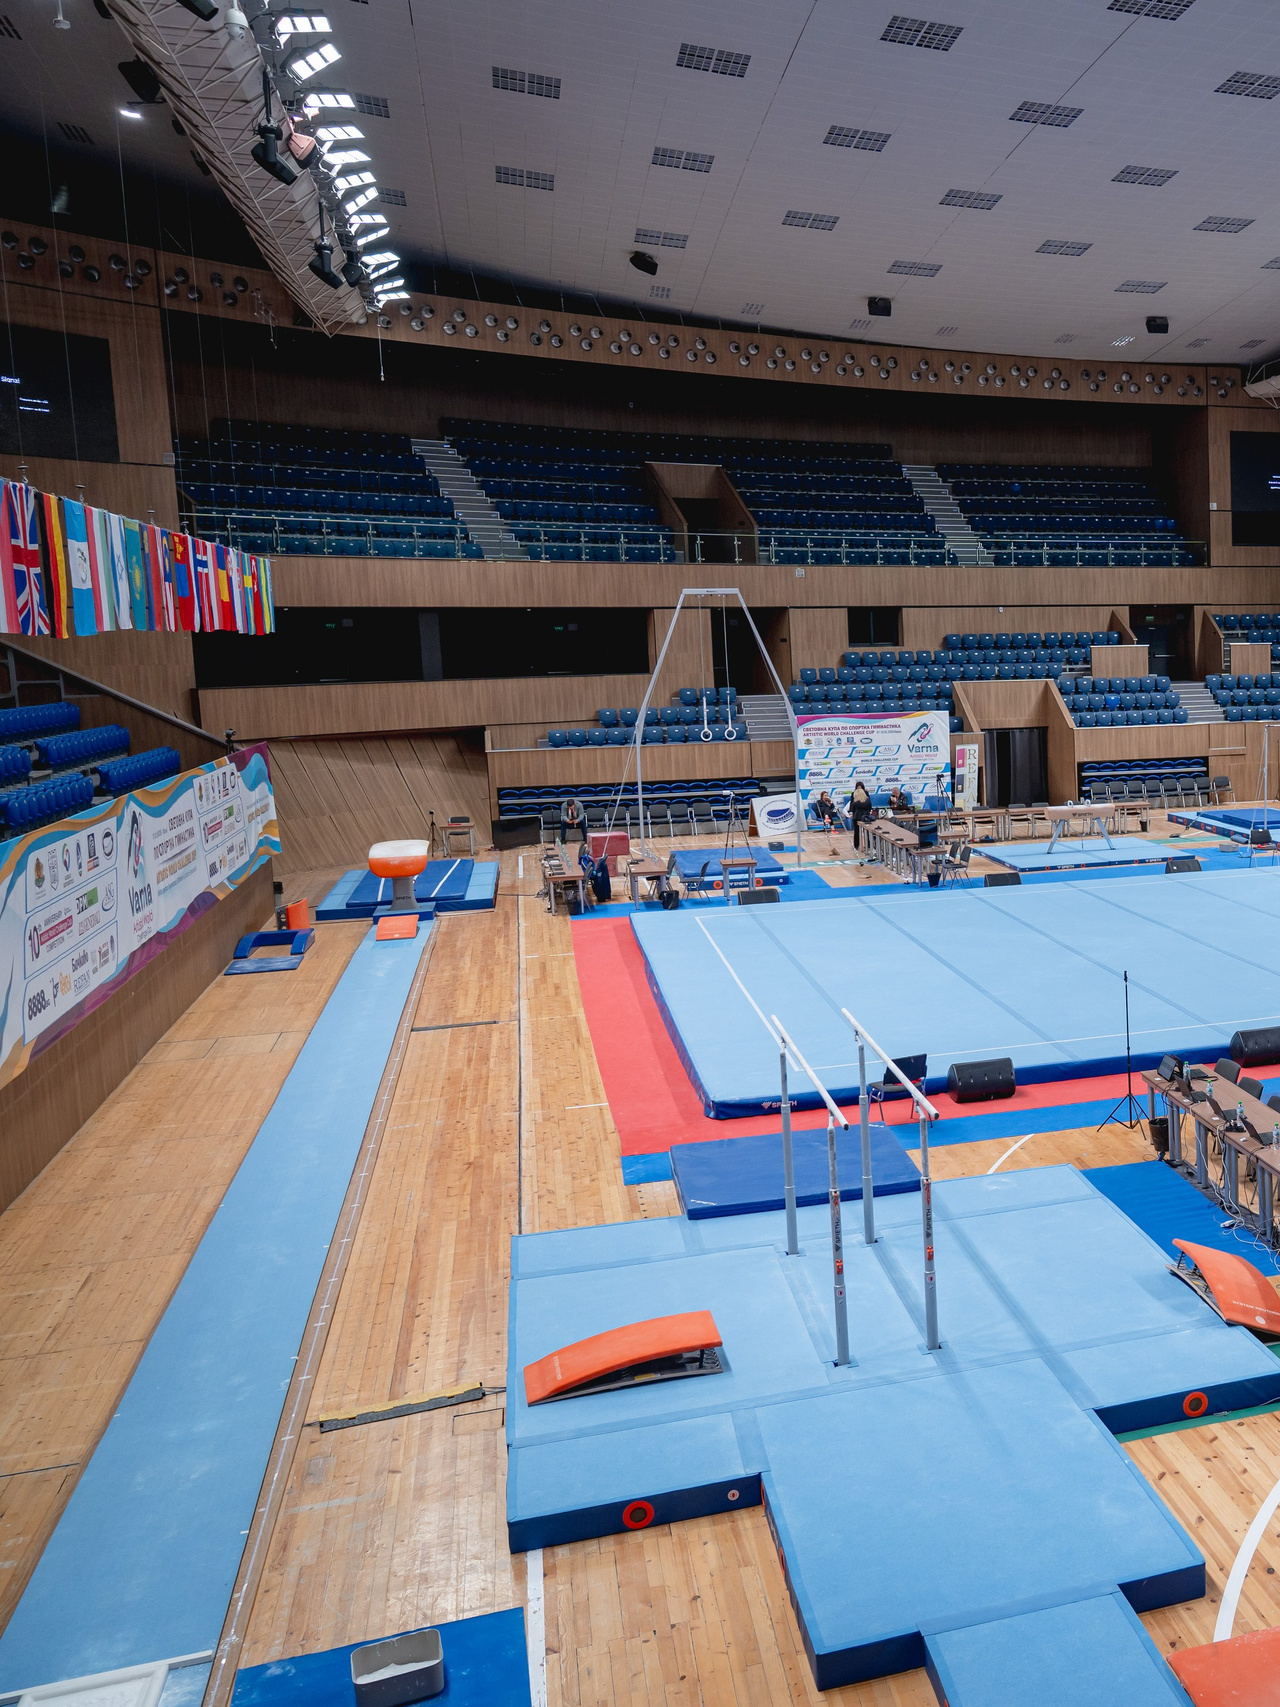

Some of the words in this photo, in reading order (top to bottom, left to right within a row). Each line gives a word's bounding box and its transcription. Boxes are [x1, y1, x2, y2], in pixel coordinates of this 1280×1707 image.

[0, 375, 20, 384] Signal
[907, 744, 939, 753] Varna
[129, 883, 152, 916] Varna
